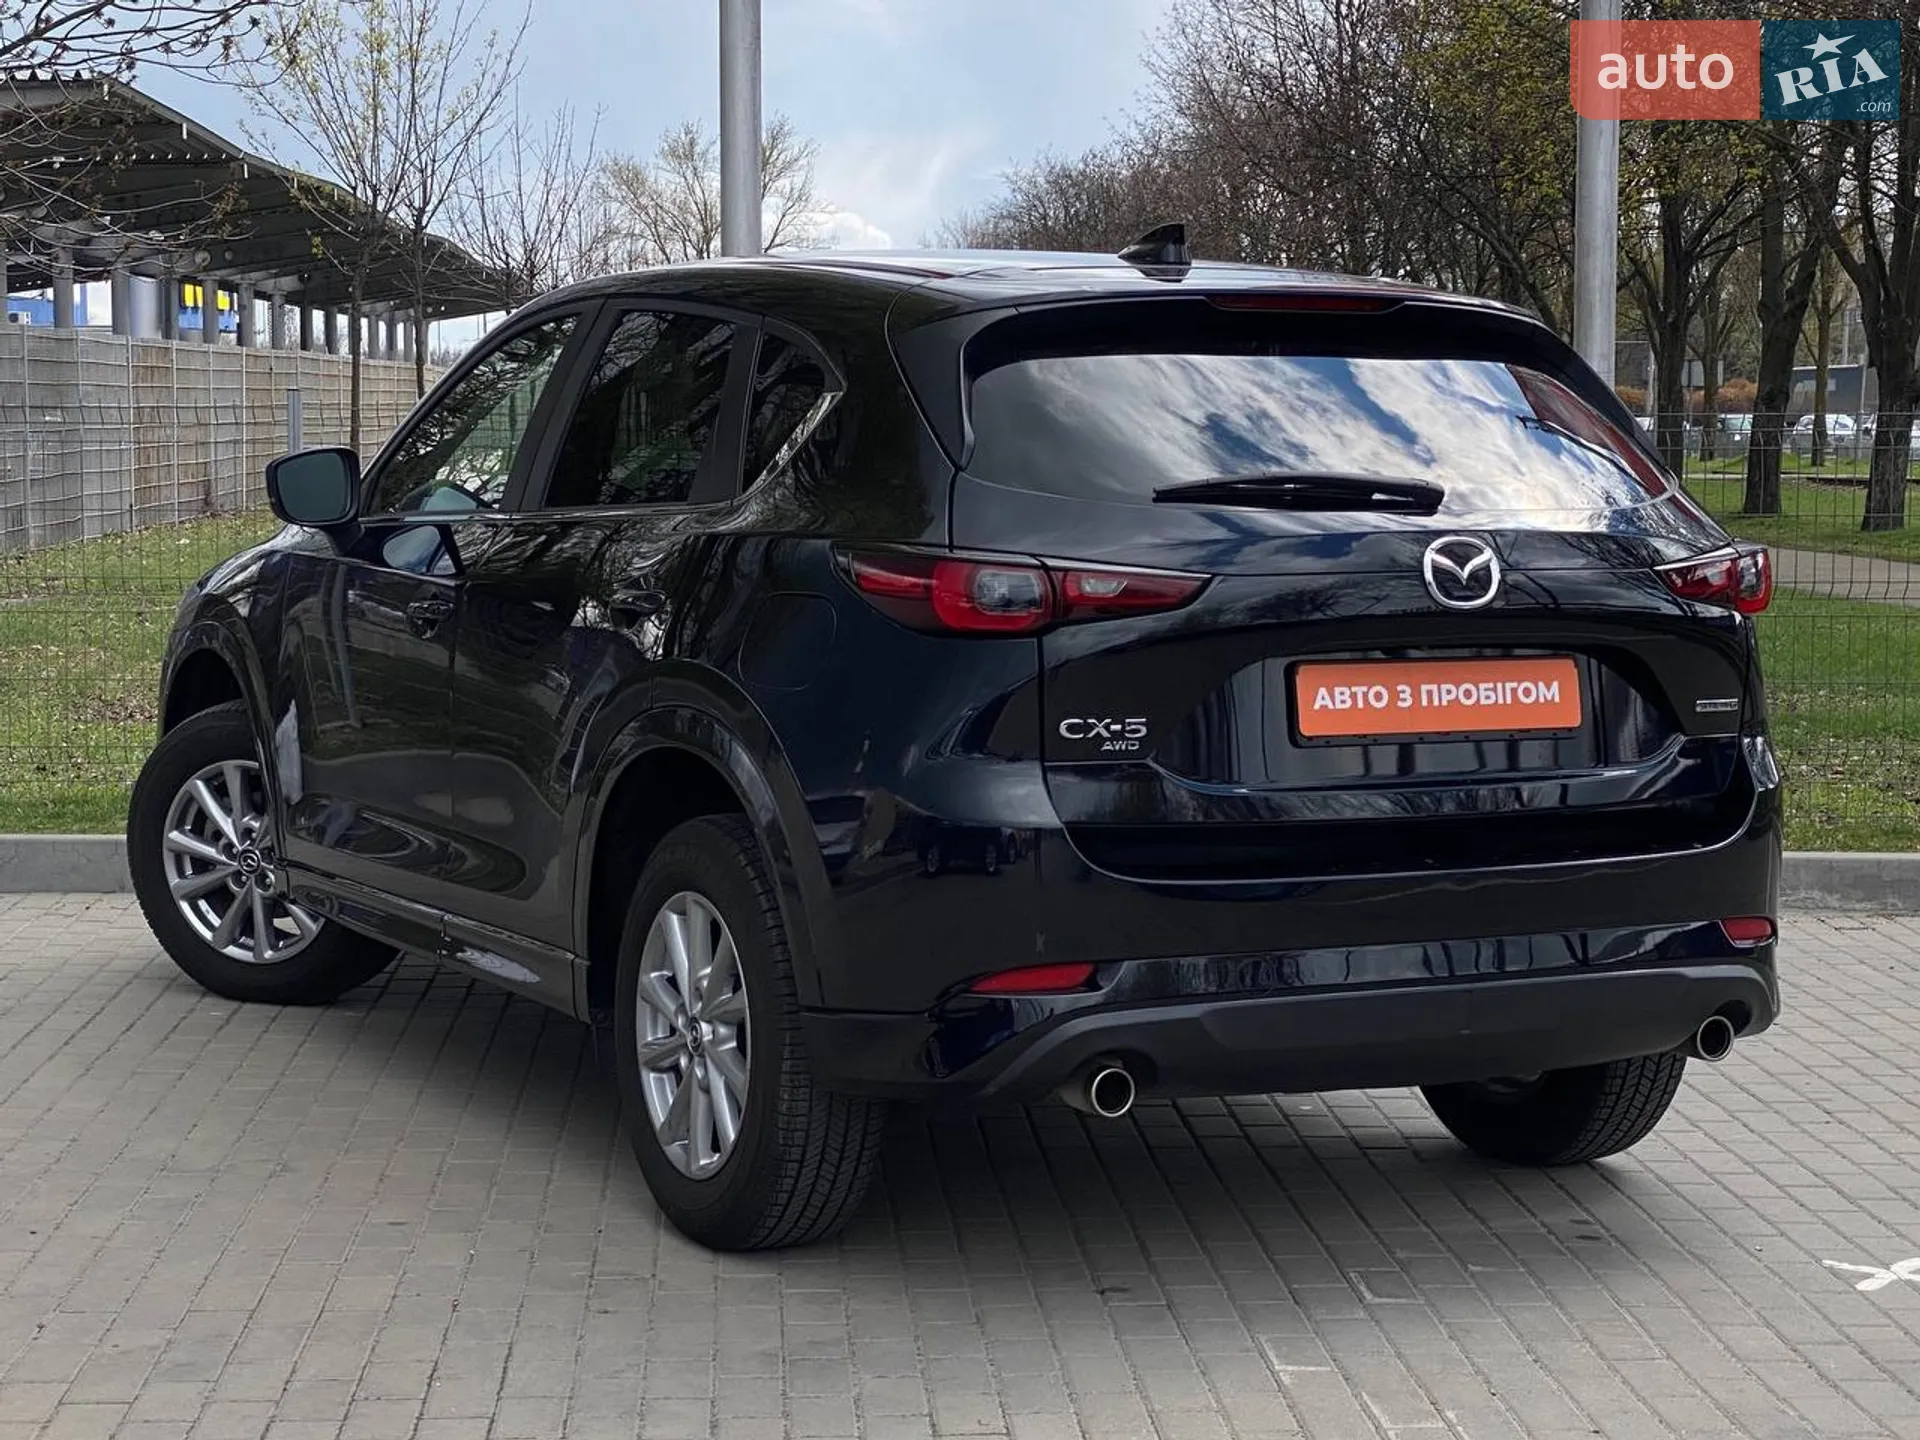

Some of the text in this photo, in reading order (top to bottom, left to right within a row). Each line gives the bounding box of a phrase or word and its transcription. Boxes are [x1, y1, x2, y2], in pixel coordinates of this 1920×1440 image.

[1313, 681, 1560, 710] АВТО З ПРОБІГОМ
[1059, 718, 1147, 739] CX-5
[1101, 740, 1140, 751] AWD
